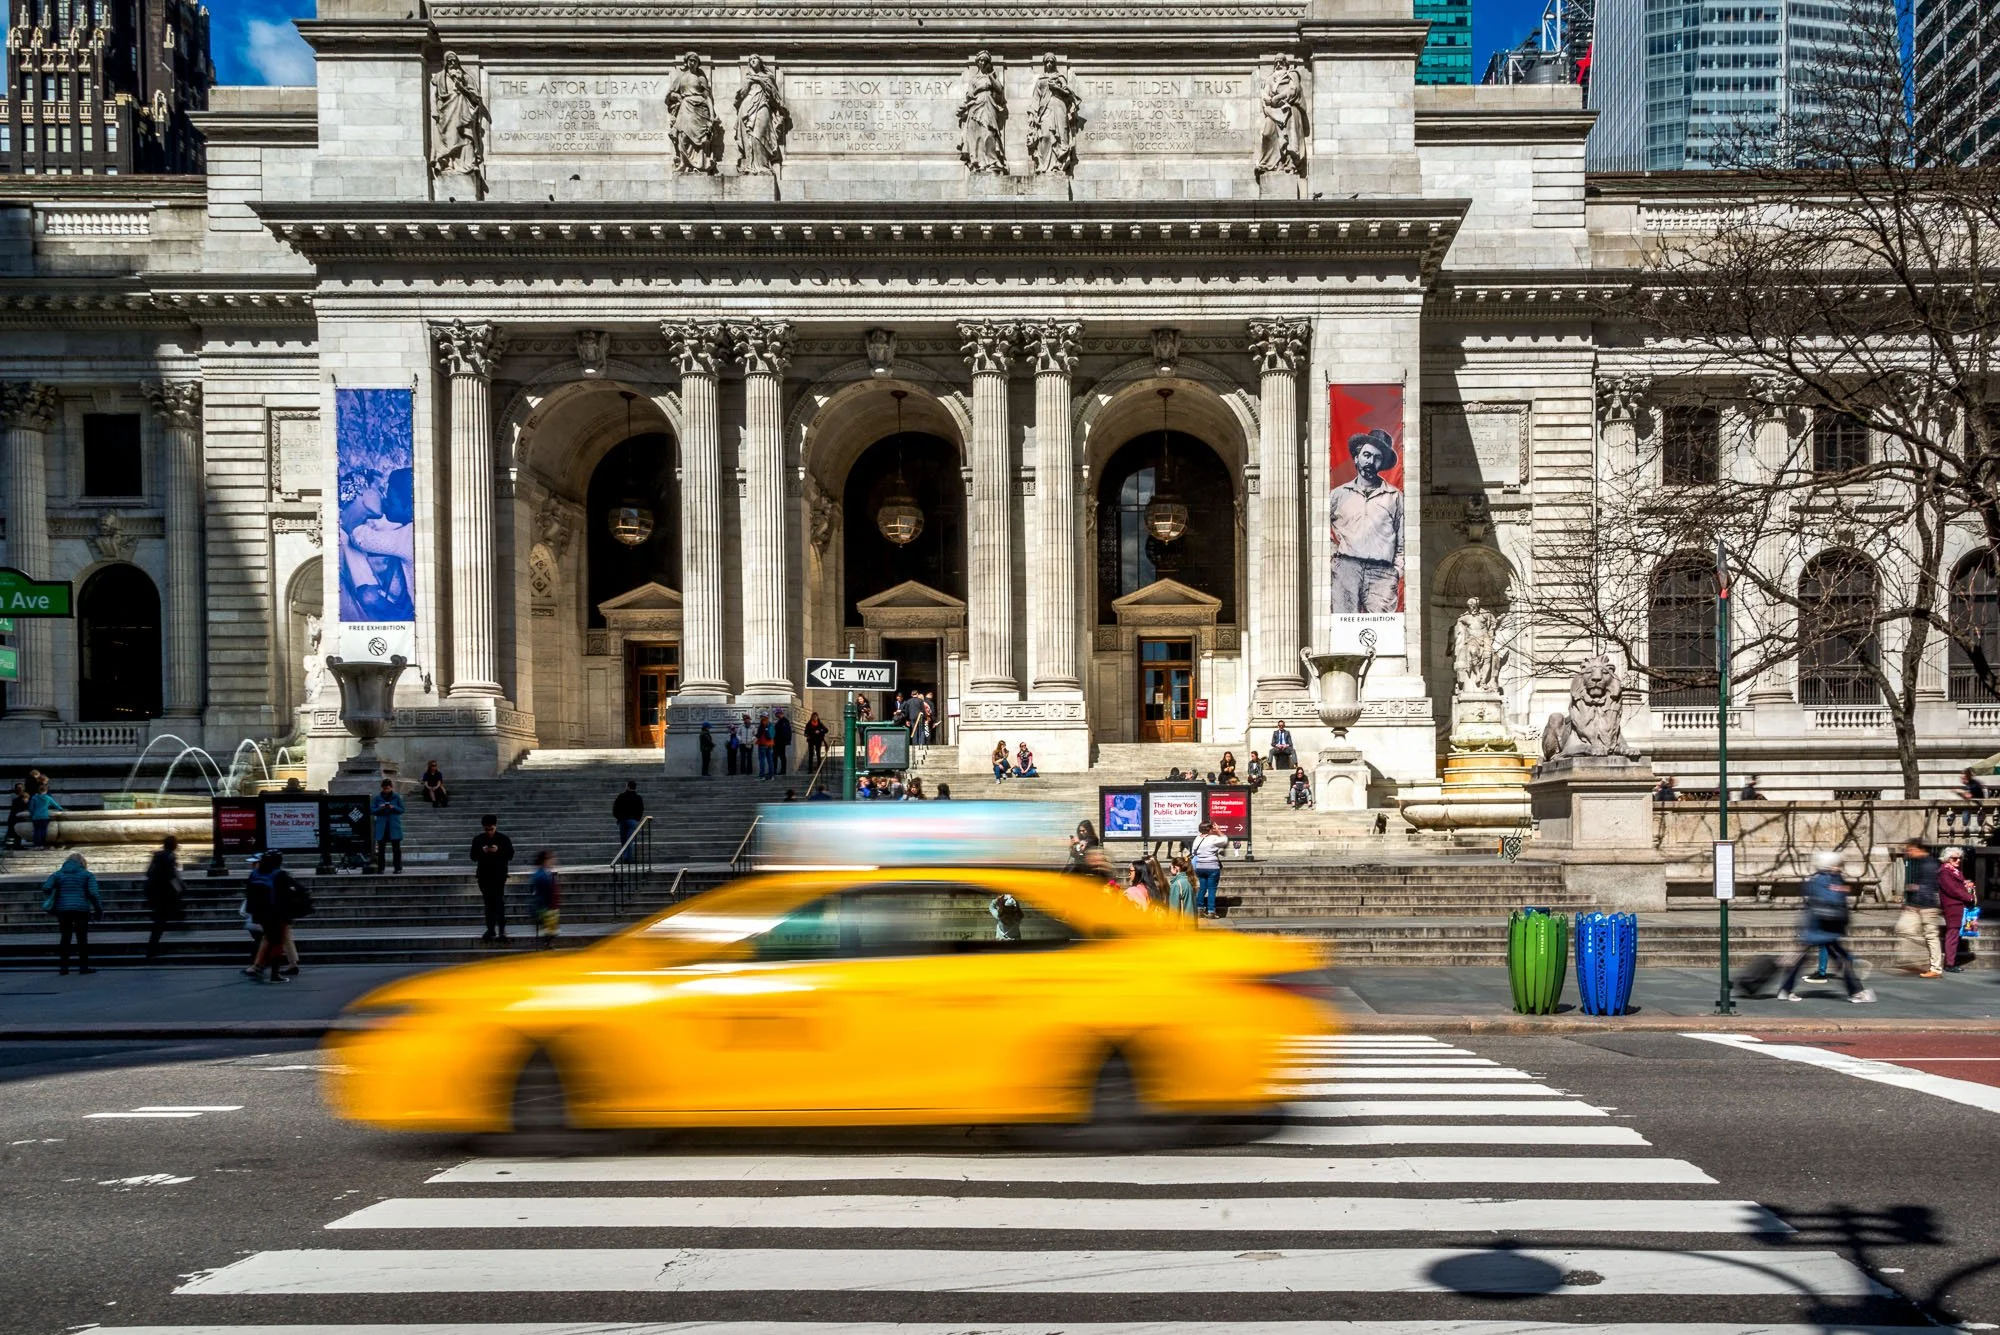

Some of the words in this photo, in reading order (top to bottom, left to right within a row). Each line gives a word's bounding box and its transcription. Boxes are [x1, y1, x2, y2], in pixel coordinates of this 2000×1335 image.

[500, 81, 528, 95] THE
[539, 81, 588, 95] ASTOR
[596, 81, 660, 95] LIBRARY
[794, 81, 823, 95] THE
[831, 81, 881, 95] LENOX
[889, 81, 953, 95] LIBRARY
[1084, 81, 1114, 95] THE
[1127, 81, 1181, 95] TILDEN
[1194, 80, 1243, 95] TRUST
[547, 101, 591, 109] FOUNDED
[601, 101, 612, 109] BY
[841, 101, 884, 109] FOUNDED
[895, 101, 905, 109] BY
[1132, 100, 1175, 109] FOUNDED
[1184, 100, 1195, 109] BY
[520, 110, 552, 121] JOHN
[558, 110, 596, 121] JACOB
[602, 110, 639, 120] ASTOR
[829, 111, 868, 121] JAMES
[878, 110, 918, 121] LENOX
[1102, 110, 1144, 120] SAMUEL
[1150, 110, 1184, 120] JONES
[1189, 110, 1227, 120] TILDEN
[558, 122, 576, 130] FOR
[582, 122, 600, 130] THE
[815, 122, 865, 131] DEDICATED
[871, 122, 884, 131] TO
[1095, 122, 1107, 130] TO
[1112, 122, 1139, 130] SERVE
[1144, 122, 1162, 130] THE
[1165, 122, 1215, 130] INTERESTS
[1219, 122, 1231, 130] OF
[497, 133, 563, 141] ADVANCEMENT
[565, 133, 576, 141] OF
[580, 133, 611, 141] USEFUL
[613, 133, 665, 141] KNOWLEDGE
[792, 133, 850, 141] LITERATURE
[858, 133, 876, 141] AND
[884, 133, 900, 141] THE
[906, 133, 926, 141] FINE
[930, 133, 954, 141] ARTS
[1084, 132, 1123, 141] SCIENCE
[1127, 132, 1146, 141] AND
[1149, 132, 1191, 141] POPULAR
[610, 267, 670, 287] THE
[694, 267, 762, 287] NEW
[790, 267, 865, 287] YORK
[889, 266, 989, 287] PUBLIC
[1017, 266, 1135, 286] LIBRARY
[11, 591, 50, 609] Ave
[820, 668, 846, 680] ONE
[857, 669, 884, 681] WAY
[270, 819, 290, 827] Public
[292, 819, 315, 827] Library
